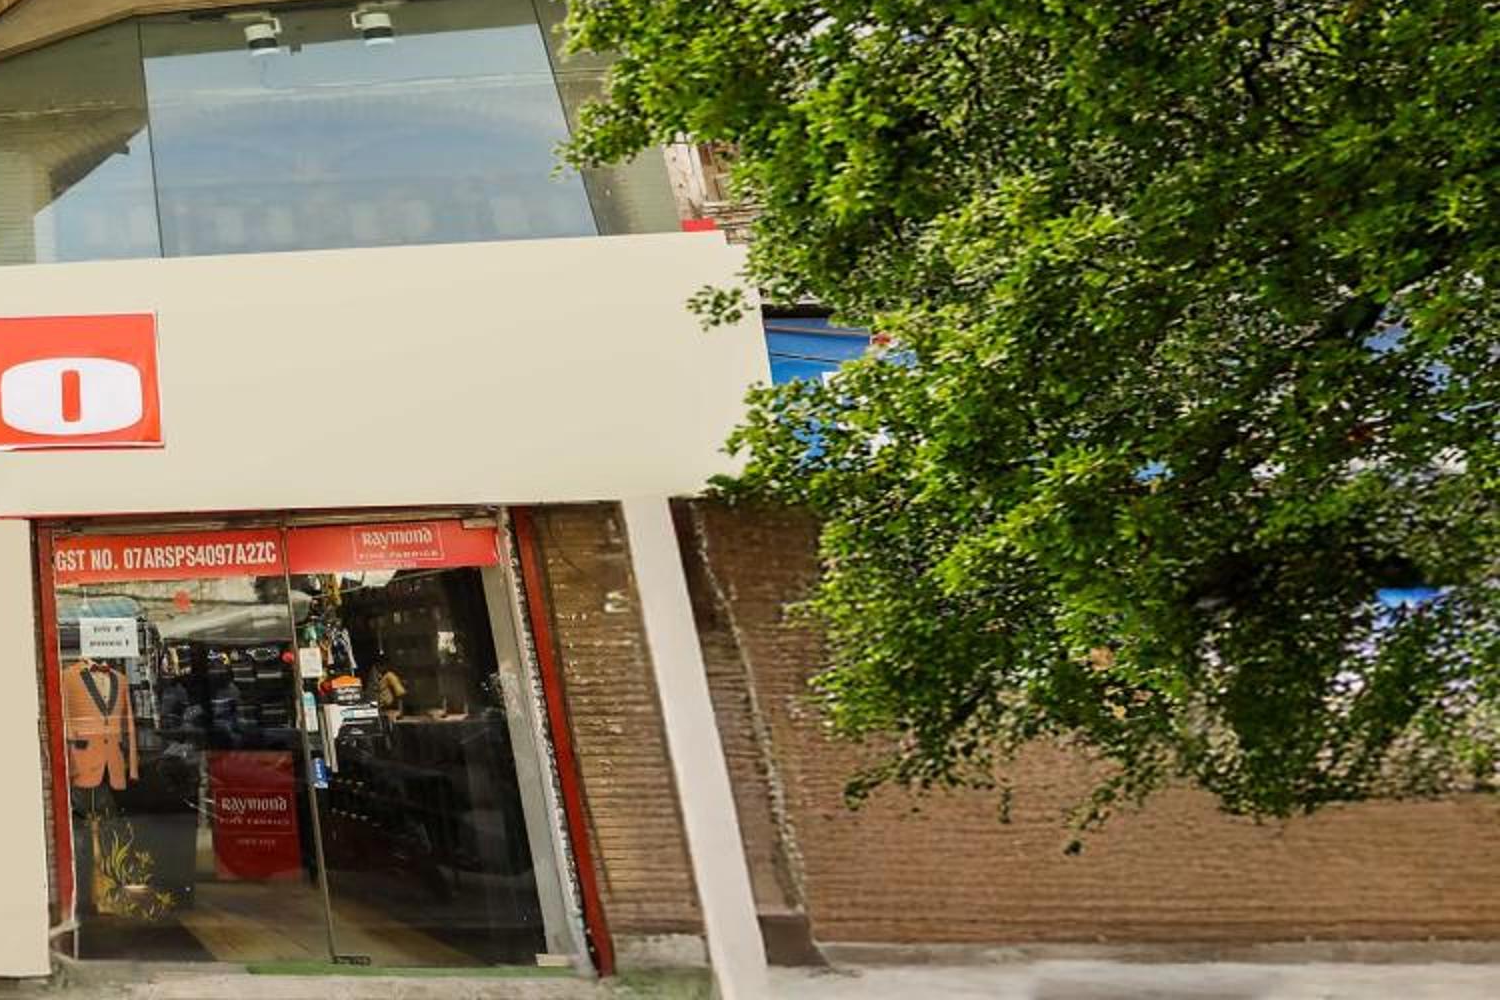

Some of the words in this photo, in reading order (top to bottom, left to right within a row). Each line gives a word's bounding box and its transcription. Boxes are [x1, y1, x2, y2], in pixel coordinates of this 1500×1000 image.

[55, 549, 86, 571] GST
[90, 548, 119, 570] NO.
[123, 541, 277, 569] 07ARSPS4097A2ZC
